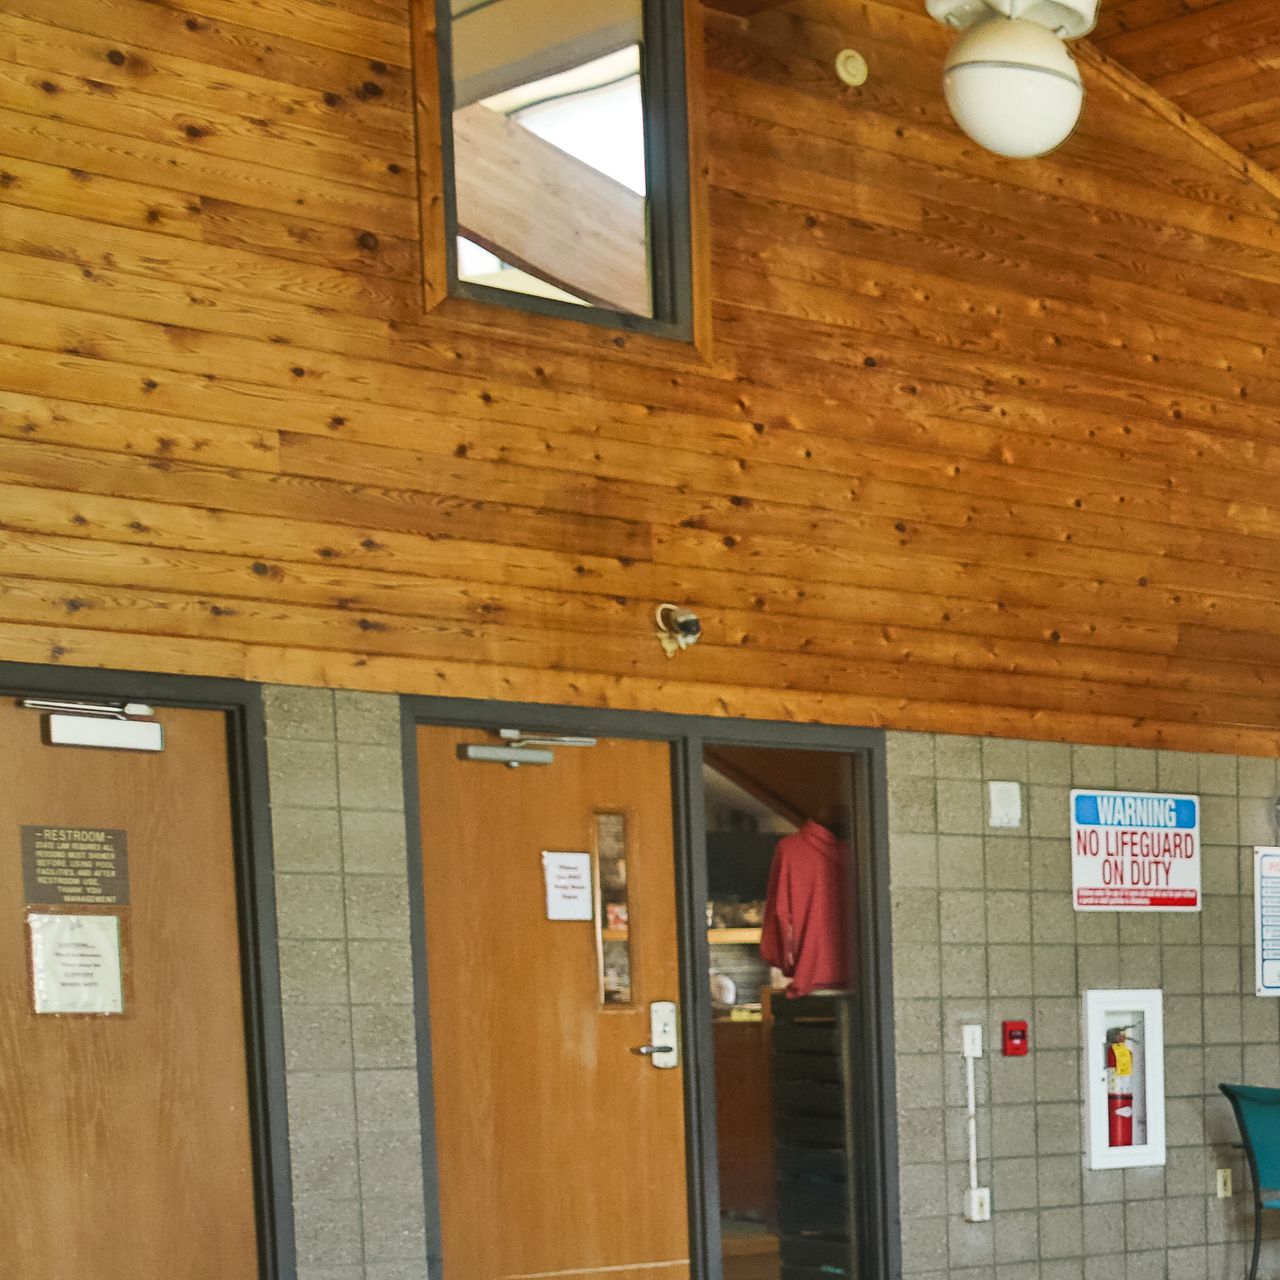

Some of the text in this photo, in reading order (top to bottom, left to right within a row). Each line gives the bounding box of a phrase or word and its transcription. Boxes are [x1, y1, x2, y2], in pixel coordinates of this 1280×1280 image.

[1097, 796, 1177, 827] WARNING
[1077, 830, 1194, 858] NO LIFEGUARD
[1102, 860, 1171, 886] ON DUTY
